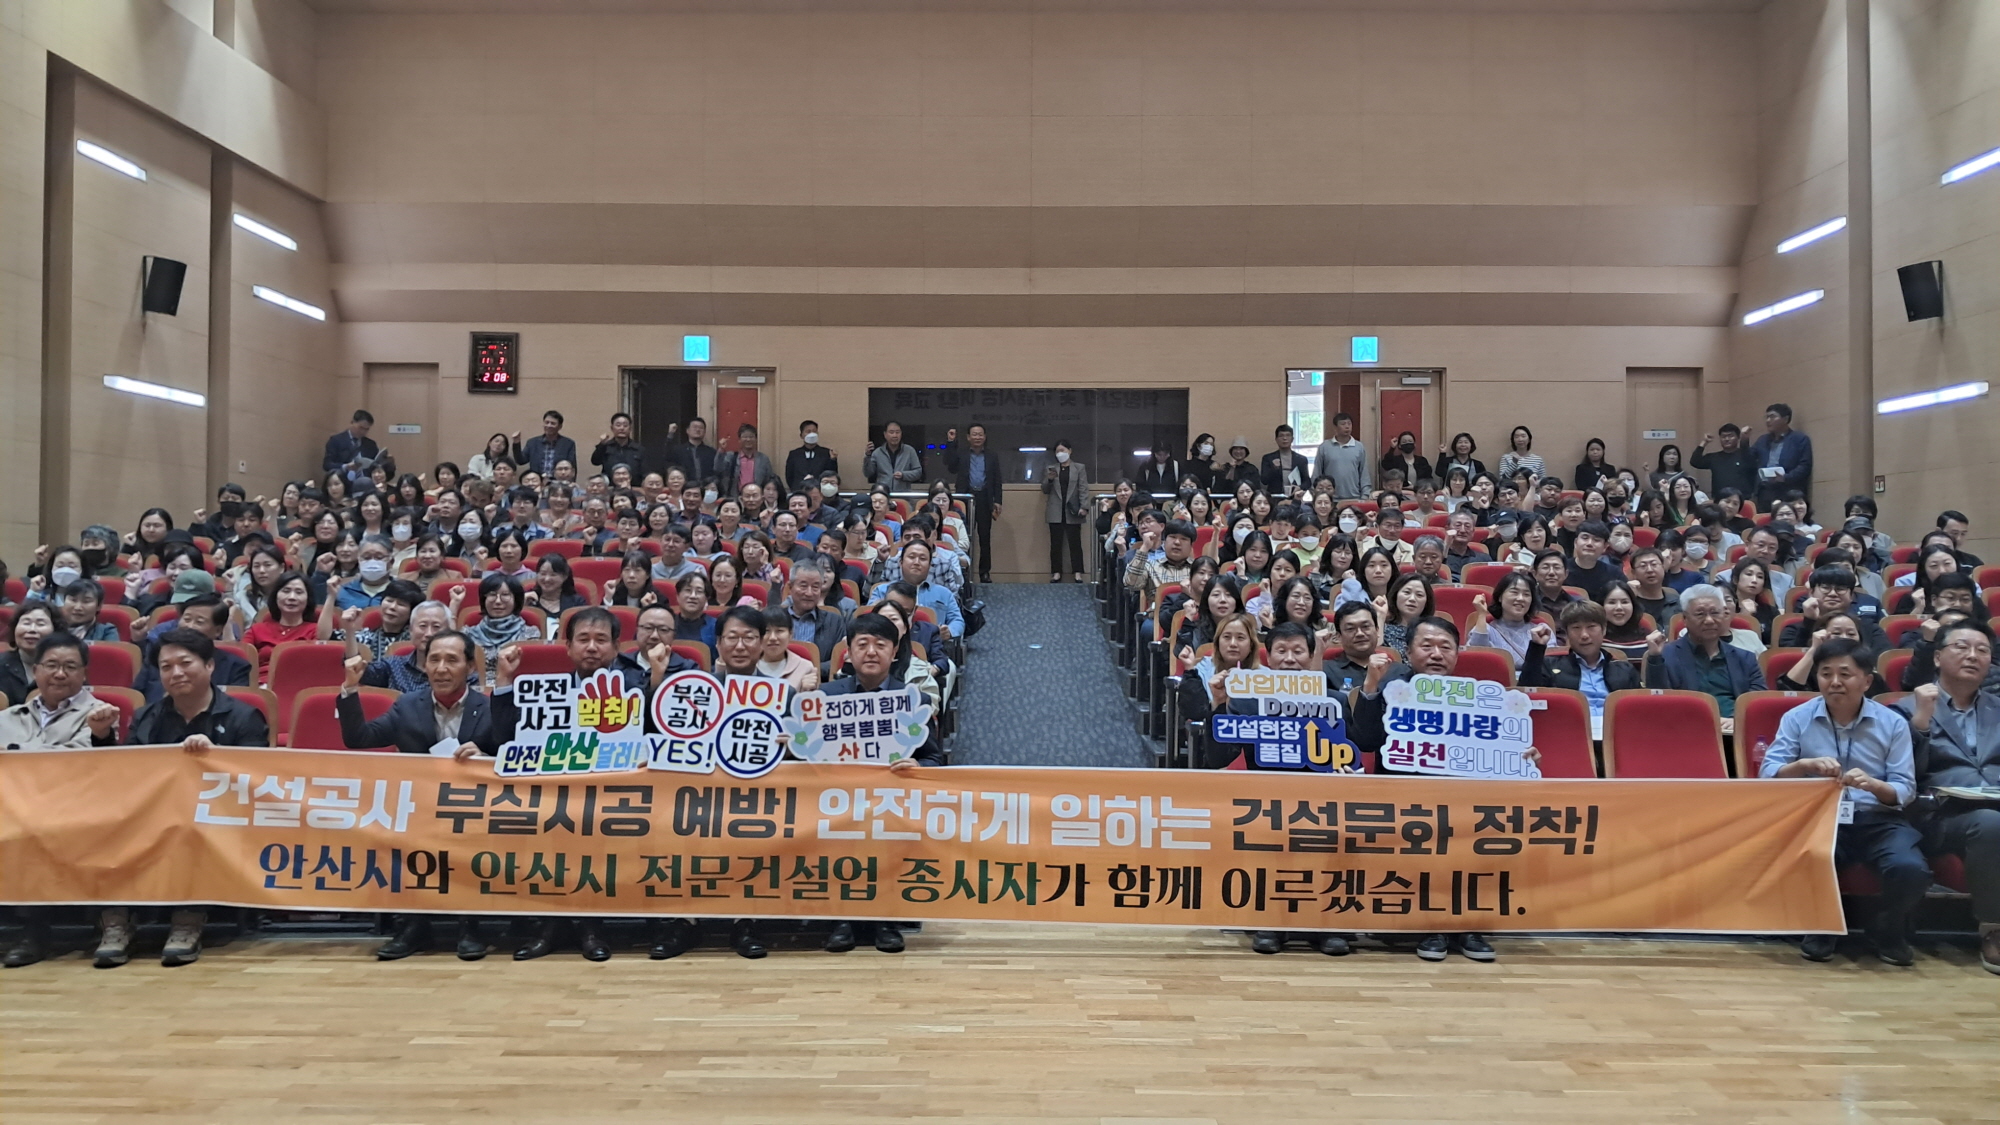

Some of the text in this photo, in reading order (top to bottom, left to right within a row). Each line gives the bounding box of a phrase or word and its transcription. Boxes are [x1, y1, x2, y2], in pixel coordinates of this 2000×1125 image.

[518, 679, 568, 703] 안전
[671, 684, 713, 707] 부실
[726, 678, 785, 710] NO!
[1229, 673, 1323, 696] 산업재해
[1415, 677, 1503, 710] 안전은
[520, 696, 641, 731] 사고 멈춰!
[667, 707, 710, 730] 공사
[801, 694, 912, 722] 안전하게 함께
[1264, 697, 1336, 720] Down
[731, 717, 772, 741] 안전
[822, 718, 900, 742] 행복뿜뿜!
[1217, 718, 1301, 741] 건설현장
[1388, 706, 1529, 743] 생명사랑의
[502, 731, 642, 773] 안전 안산 달려!
[650, 737, 714, 768] YES!
[727, 741, 769, 766] 시공
[1259, 722, 1354, 770] 품질 Up
[1387, 739, 1538, 778] 실천입니다.
[194, 772, 1600, 856] 건설공사 부실시공 예방! 안전하게 일하는 건설문화 정착!
[258, 843, 1526, 918] 안산시와 안산시 전문건설업 종사자가 함께 이루겠습니다.
